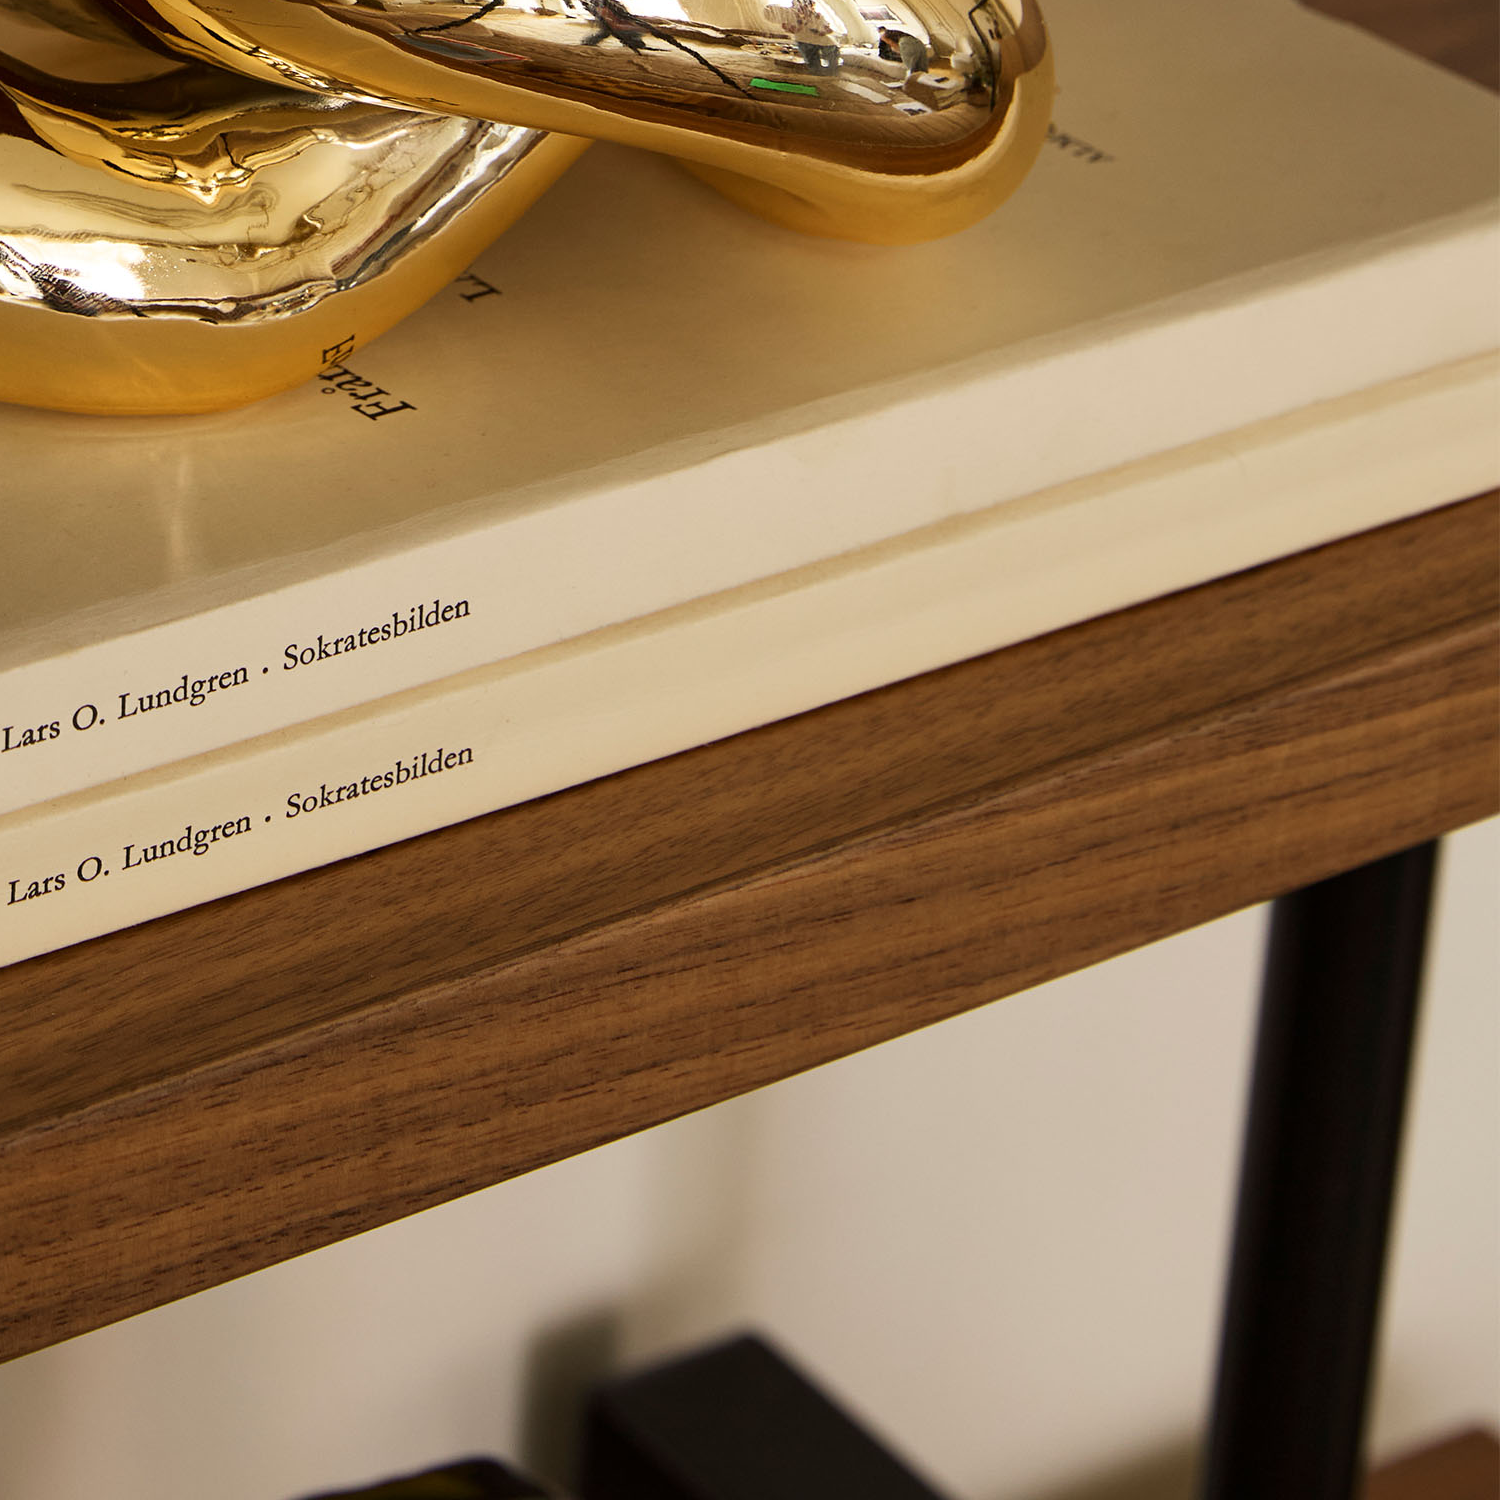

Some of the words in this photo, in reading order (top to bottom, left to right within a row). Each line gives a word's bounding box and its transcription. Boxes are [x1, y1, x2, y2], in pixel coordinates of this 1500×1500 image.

[0, 720, 62, 753] Lars
[71, 704, 106, 732] O.
[116, 665, 250, 720] Lundgren
[282, 598, 471, 671] Sokratesbilden
[7, 872, 67, 906] Lars
[76, 855, 111, 883] O.
[121, 814, 253, 871] Lundgren
[285, 746, 474, 819] Sokratesbilden
